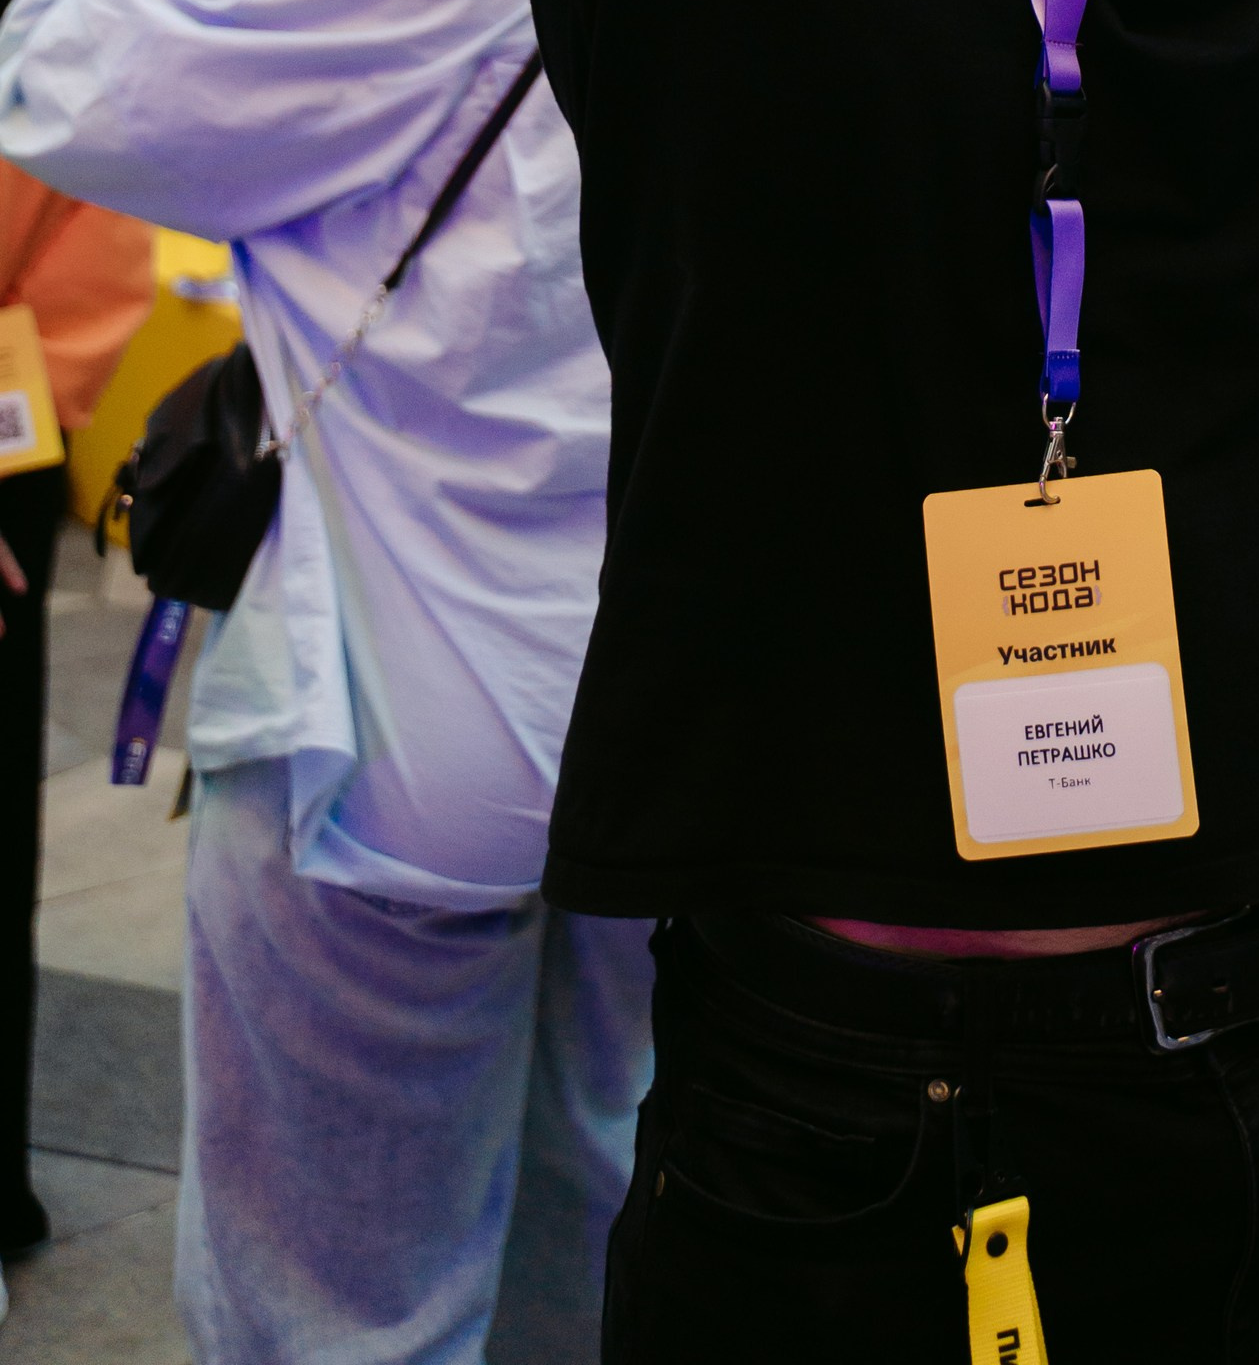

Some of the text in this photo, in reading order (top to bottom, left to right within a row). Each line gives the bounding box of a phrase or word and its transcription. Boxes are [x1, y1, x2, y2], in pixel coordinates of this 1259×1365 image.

[997, 637, 1116, 665] Участник
[1024, 714, 1104, 741] ЕВГЕНИЙ
[1018, 742, 1116, 767] ПЕТРАШКО
[1048, 776, 1091, 789] Т-Банк
